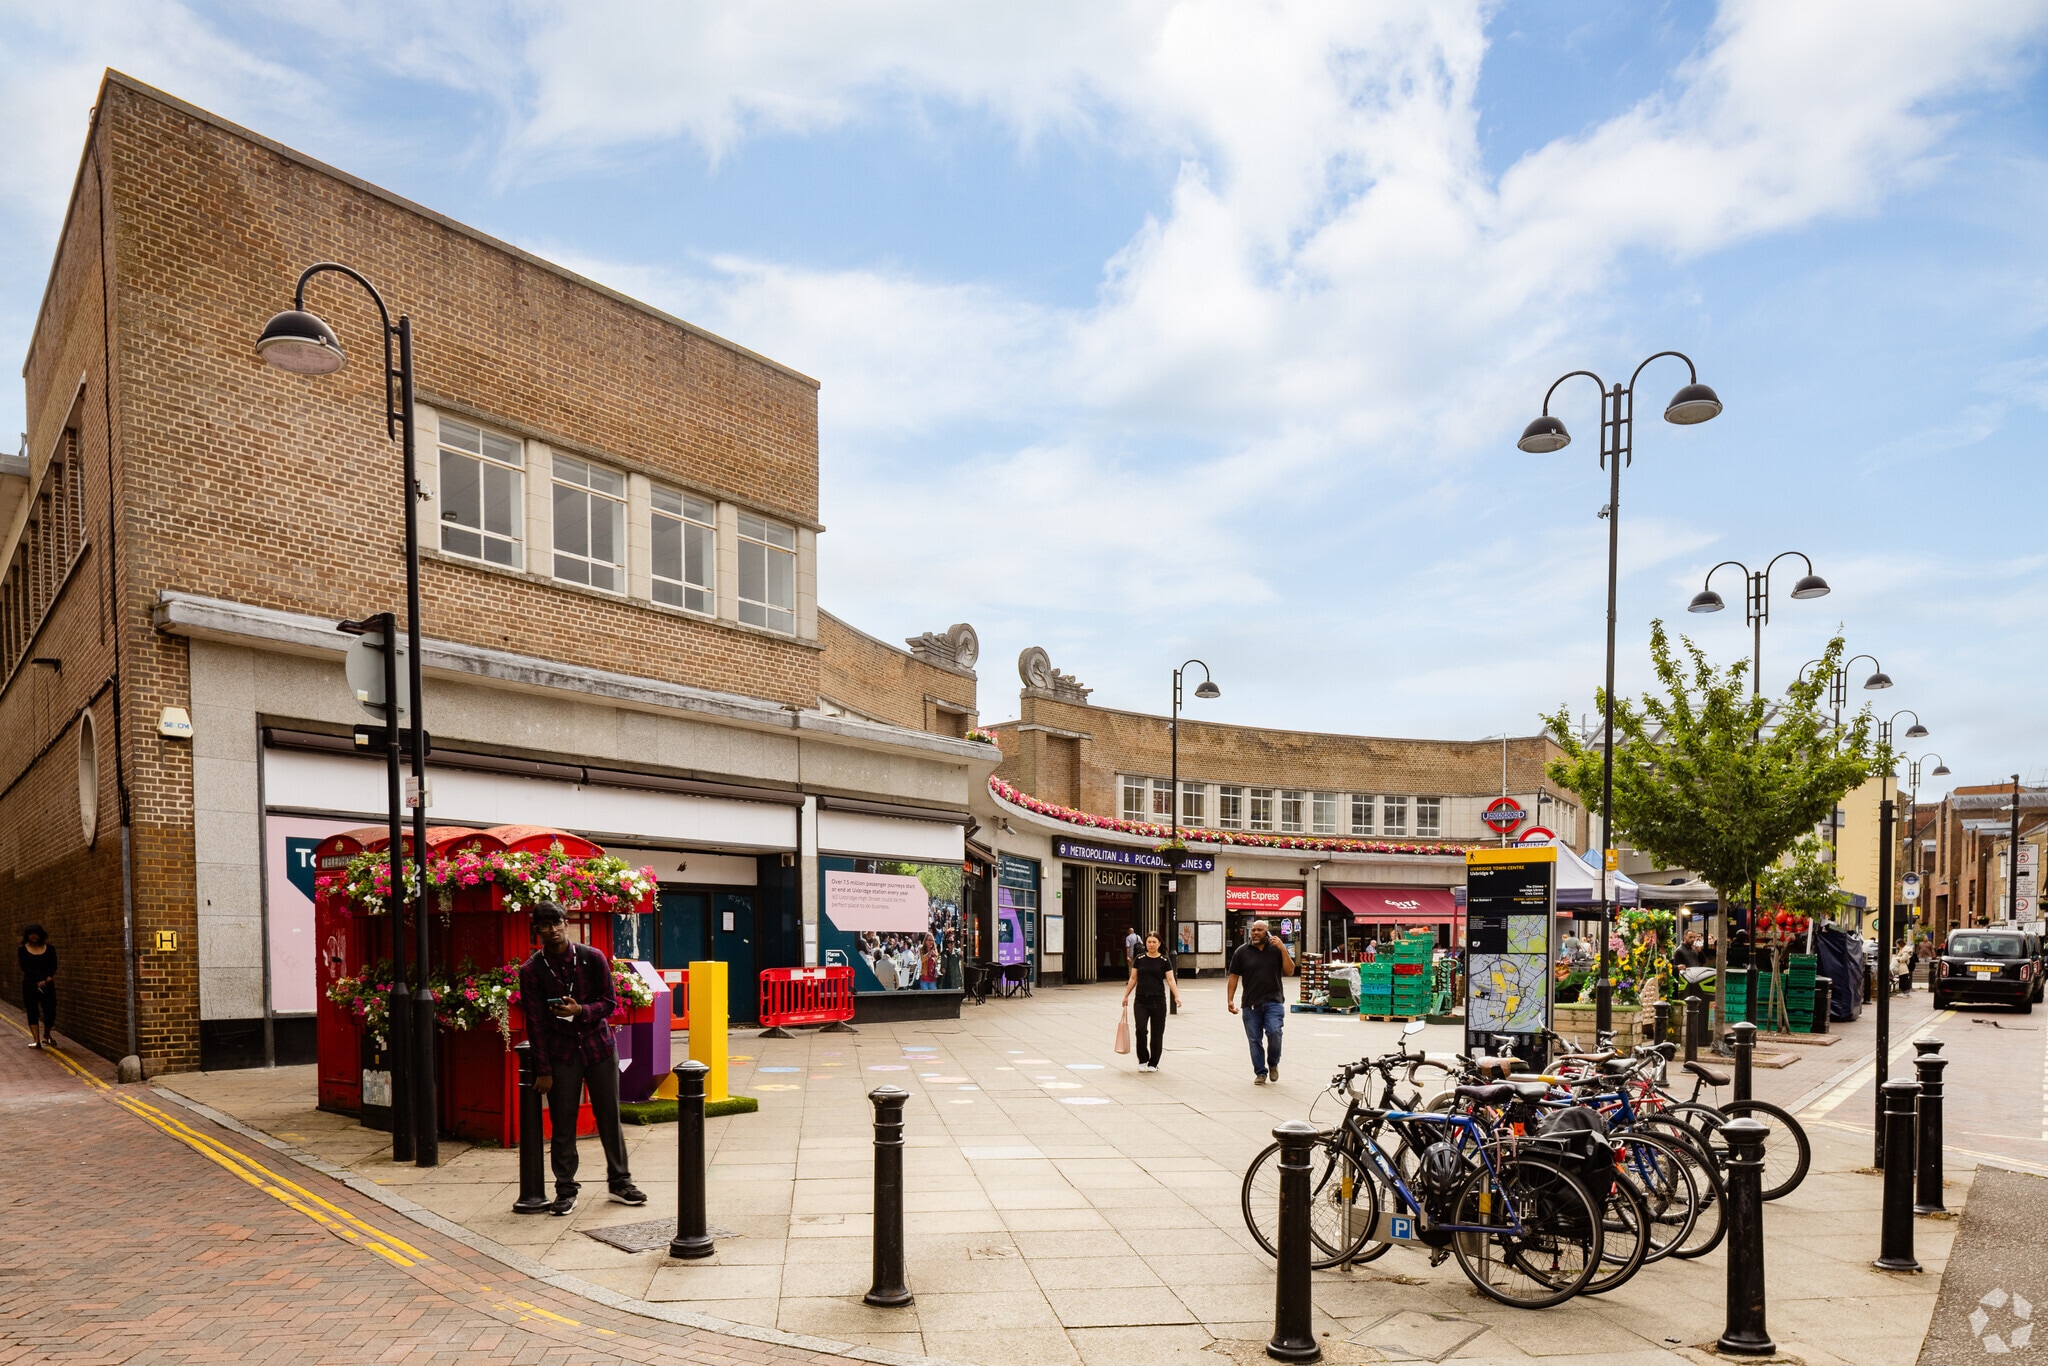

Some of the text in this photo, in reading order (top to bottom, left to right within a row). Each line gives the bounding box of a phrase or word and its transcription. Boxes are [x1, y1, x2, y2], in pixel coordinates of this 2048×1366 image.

[1483, 811, 1525, 820] UNDERGROUND
[1069, 845, 1117, 861] METROPOLITAN
[1124, 854, 1130, 863] &
[1134, 854, 1171, 867] PICCADI
[1095, 870, 1137, 887] XBRIDGE
[1226, 889, 1280, 902] Sweet Express
[160, 932, 174, 949] H
[1395, 1219, 1408, 1236] P
